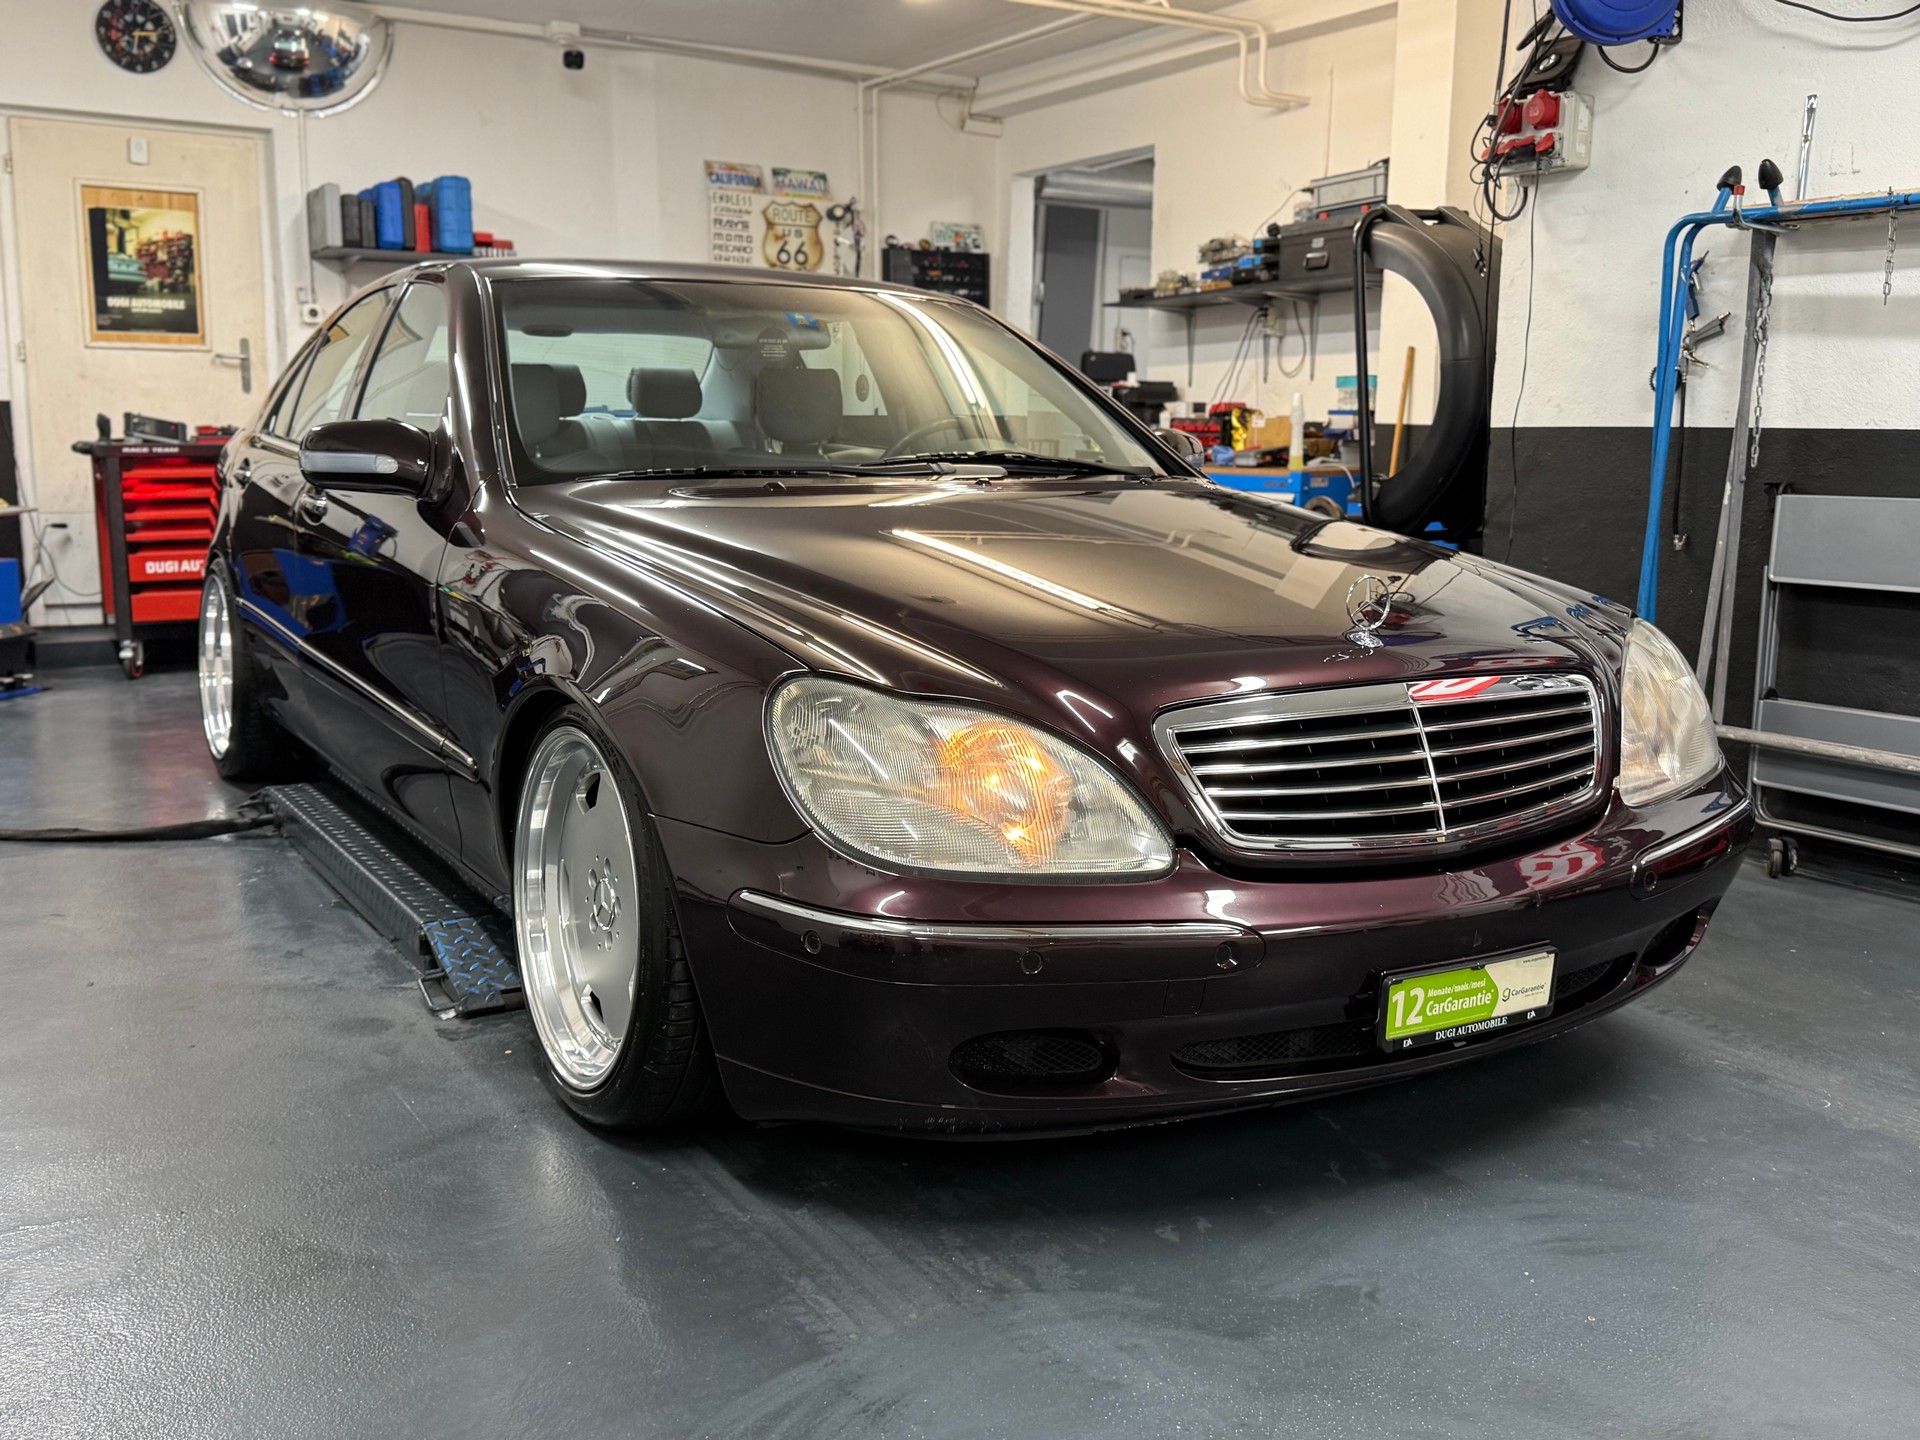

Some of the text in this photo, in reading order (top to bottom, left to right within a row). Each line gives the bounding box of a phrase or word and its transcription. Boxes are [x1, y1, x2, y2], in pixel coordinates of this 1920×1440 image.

[713, 191, 752, 207] ENDLESS
[772, 207, 813, 222] ROUTE
[776, 240, 809, 266] 66
[131, 298, 185, 310] AUTOMOBILE
[145, 561, 178, 574] DUGI
[1392, 987, 1425, 1028] 12
[1435, 1029, 1456, 1040] DUGI
[1457, 1016, 1508, 1036] AUTOMOBILE
